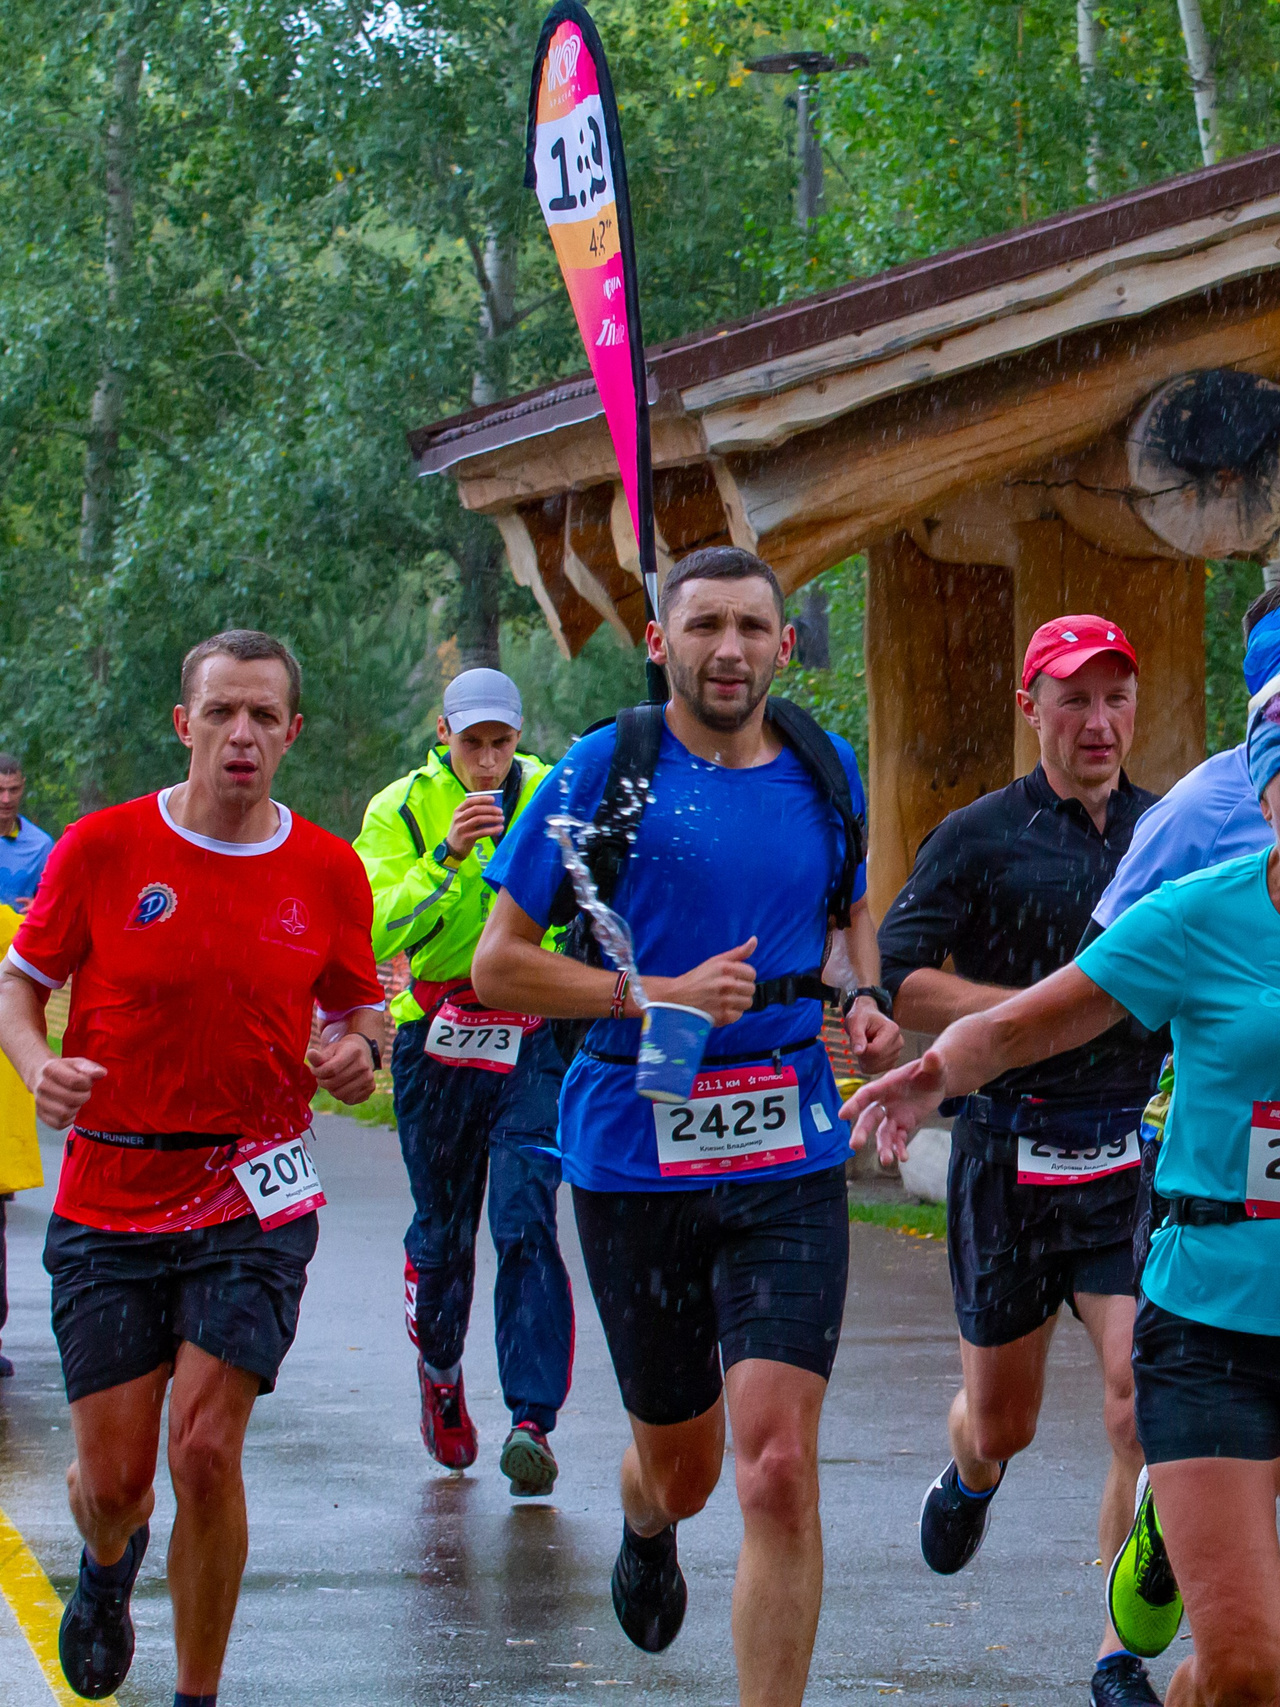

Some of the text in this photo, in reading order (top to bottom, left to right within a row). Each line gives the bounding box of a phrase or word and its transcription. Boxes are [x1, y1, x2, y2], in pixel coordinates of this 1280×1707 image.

[436, 1025, 511, 1050] 2773
[697, 1079, 723, 1092] 21.1
[669, 1095, 786, 1142] 2425
[102, 1131, 145, 1145] RUNNER
